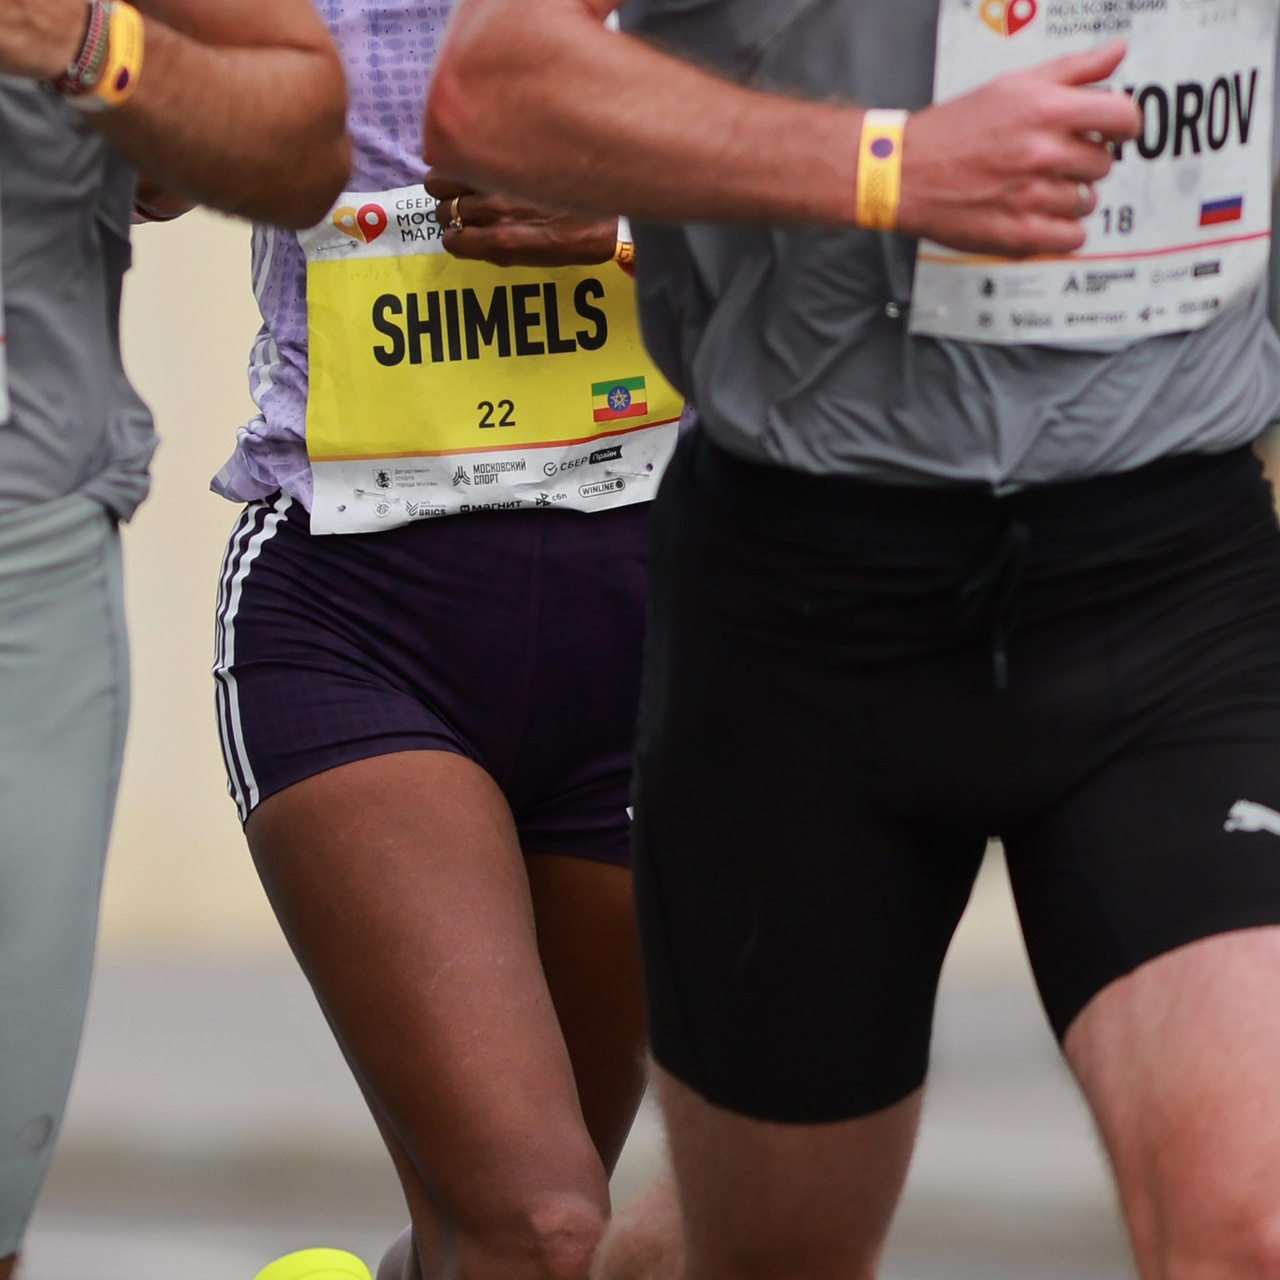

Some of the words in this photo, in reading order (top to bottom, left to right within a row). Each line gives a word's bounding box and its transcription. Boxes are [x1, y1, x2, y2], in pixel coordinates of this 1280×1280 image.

[1103, 205, 1133, 233] 18
[372, 278, 608, 366] SHIMELS
[477, 400, 516, 429] 22
[473, 459, 526, 474] МОСКОВСКИЙ
[560, 457, 588, 471] СБЕР
[592, 451, 617, 461] Прайм
[474, 473, 499, 486] СПОРТ
[582, 482, 615, 495] WINLINE
[552, 493, 568, 501] сбп
[419, 508, 446, 516] BRICS
